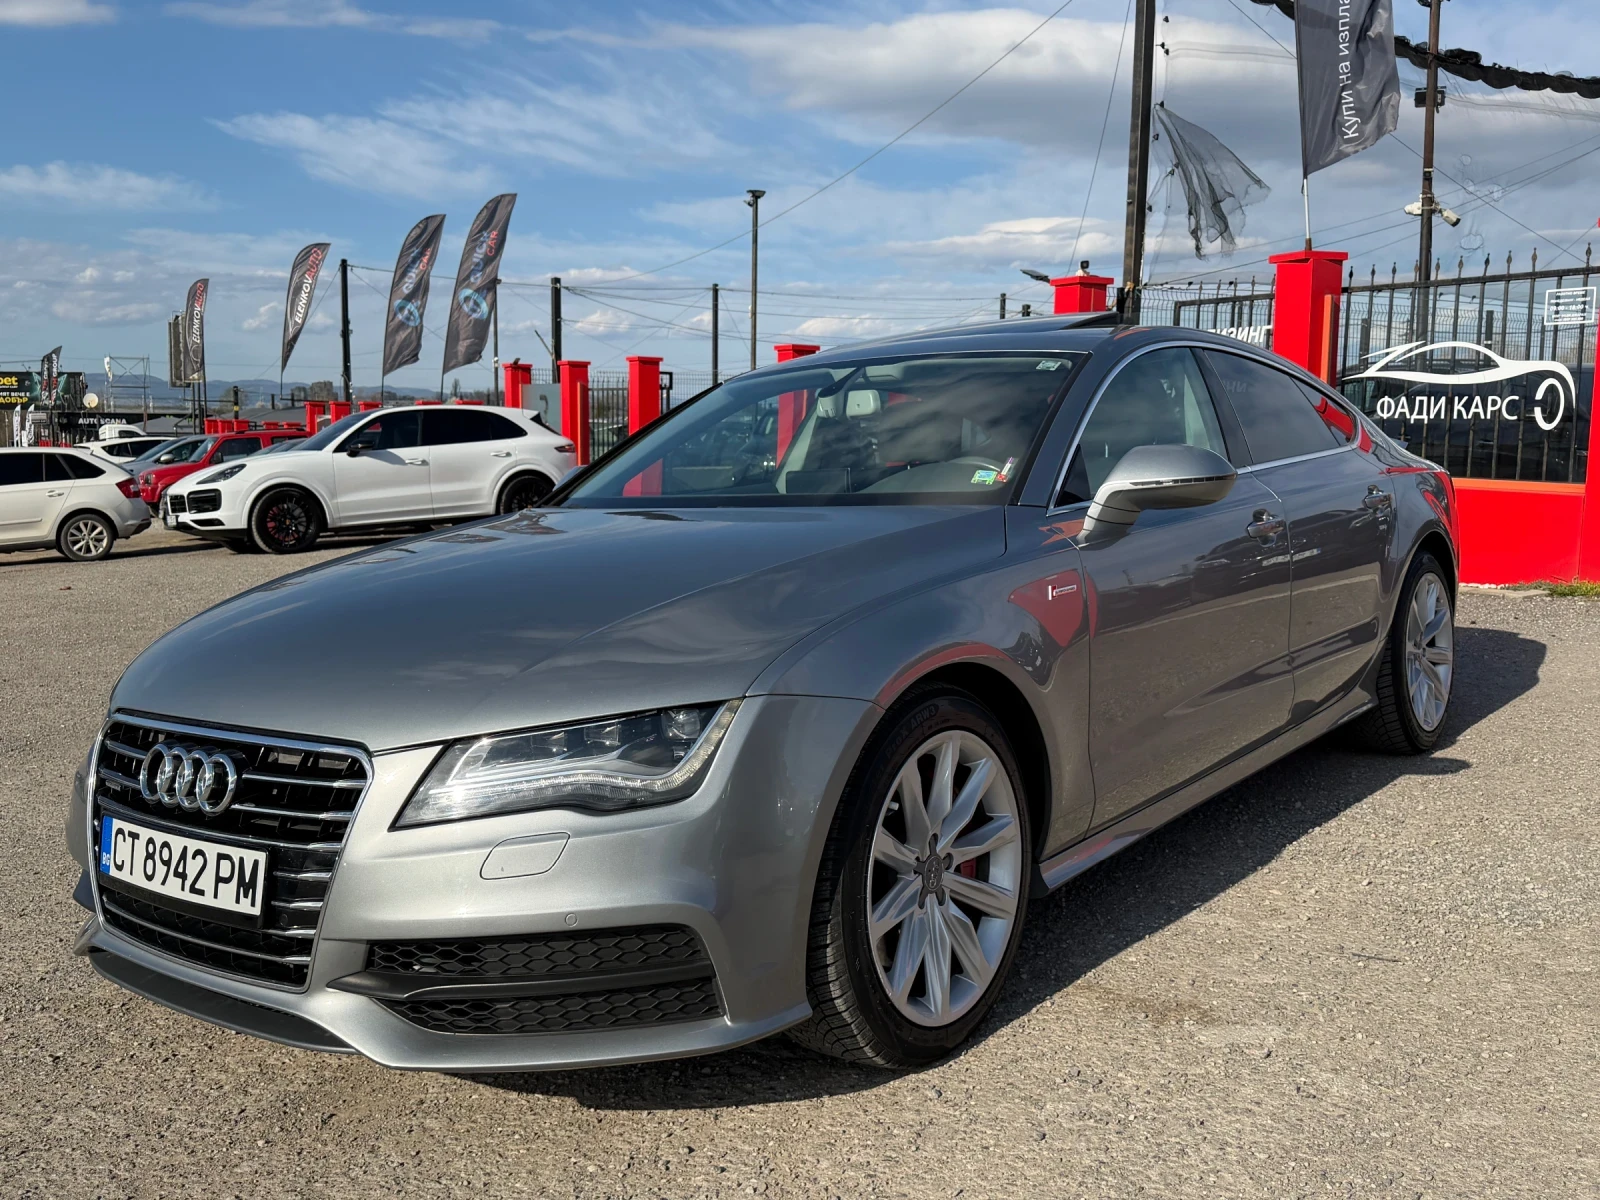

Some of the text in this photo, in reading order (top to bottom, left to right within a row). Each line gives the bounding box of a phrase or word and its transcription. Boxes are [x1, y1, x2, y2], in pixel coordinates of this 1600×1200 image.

[1339, 61, 1352, 86] на
[1342, 90, 1361, 139] Купи
[486, 230, 499, 256] CAR
[294, 247, 323, 324] ELENKOVAUTO
[192, 282, 204, 343] ELENKOVAUTO
[1376, 395, 1520, 424] ФАДИ КАРС
[910, 705, 937, 729] ARW3
[102, 852, 111, 866] BG
[113, 827, 260, 908] CT 8942 PM
